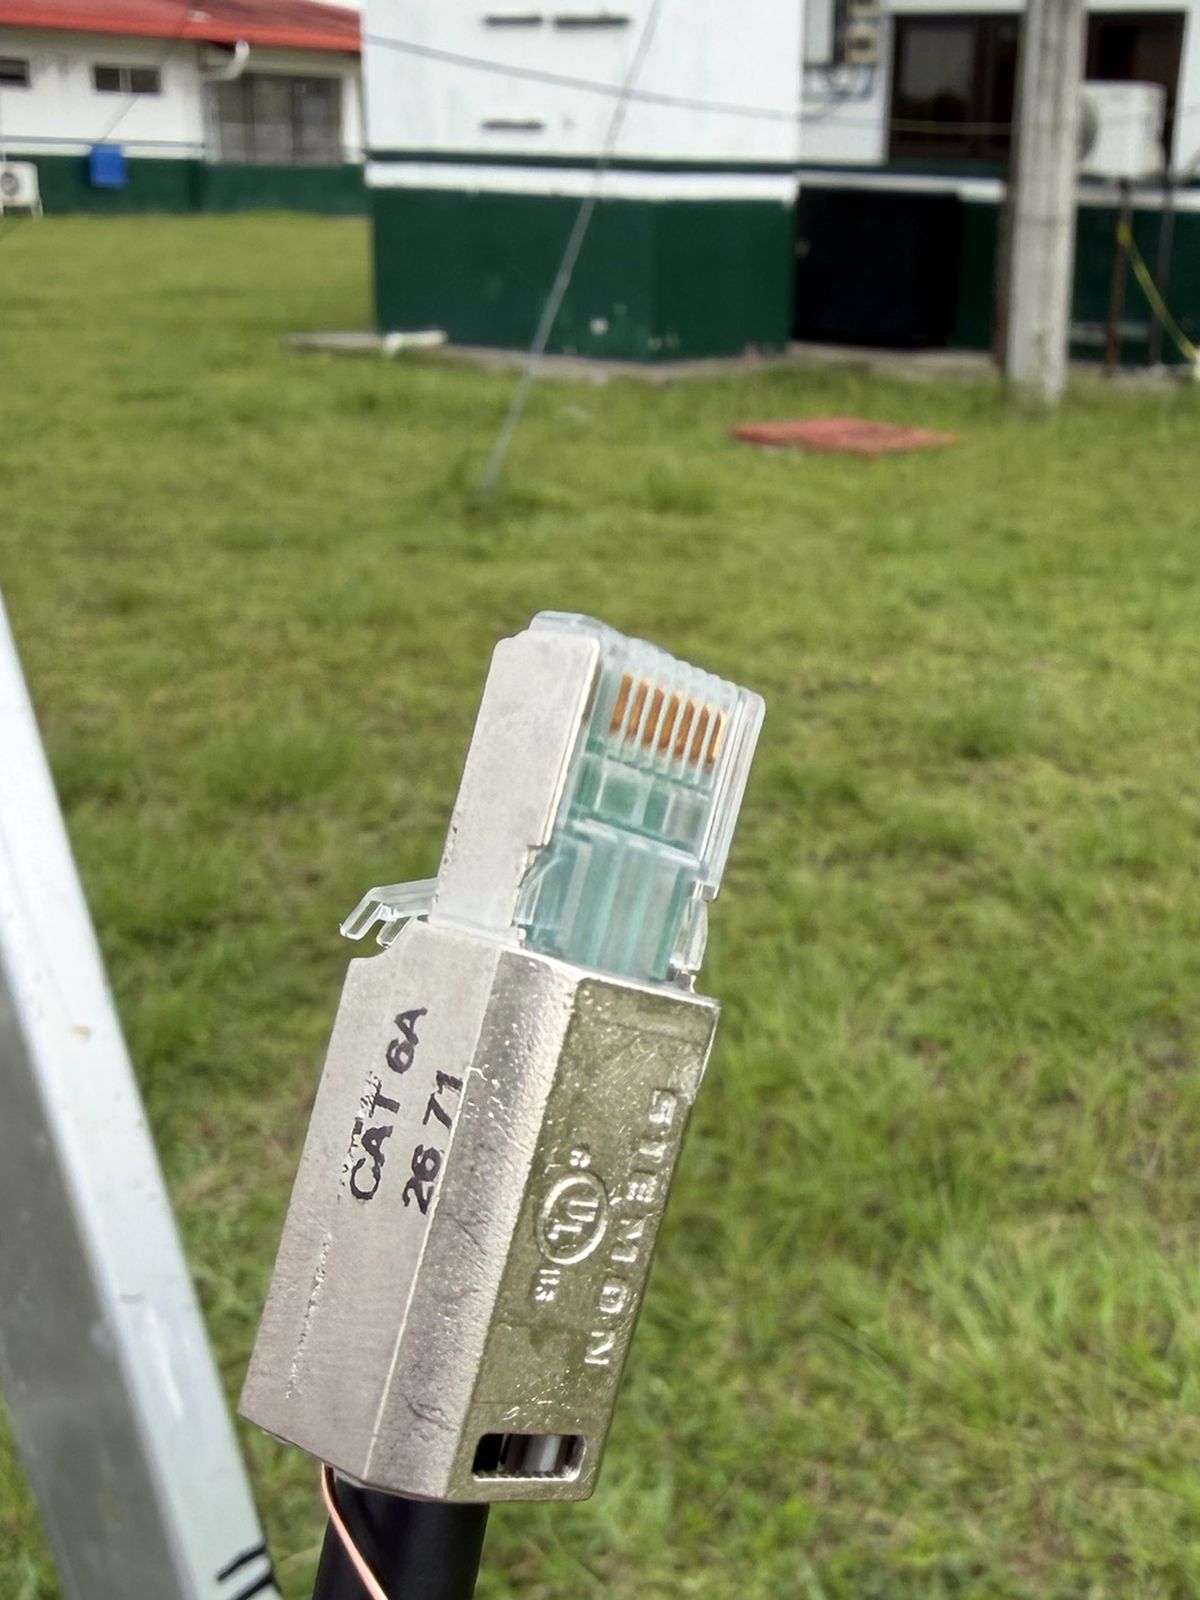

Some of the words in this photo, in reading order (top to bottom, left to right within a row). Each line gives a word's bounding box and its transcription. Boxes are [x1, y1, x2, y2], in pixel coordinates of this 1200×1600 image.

[350, 1070, 401, 1200] CAT
[386, 1007, 428, 1074] 6A
[583, 1088, 677, 1365] SIEMON
